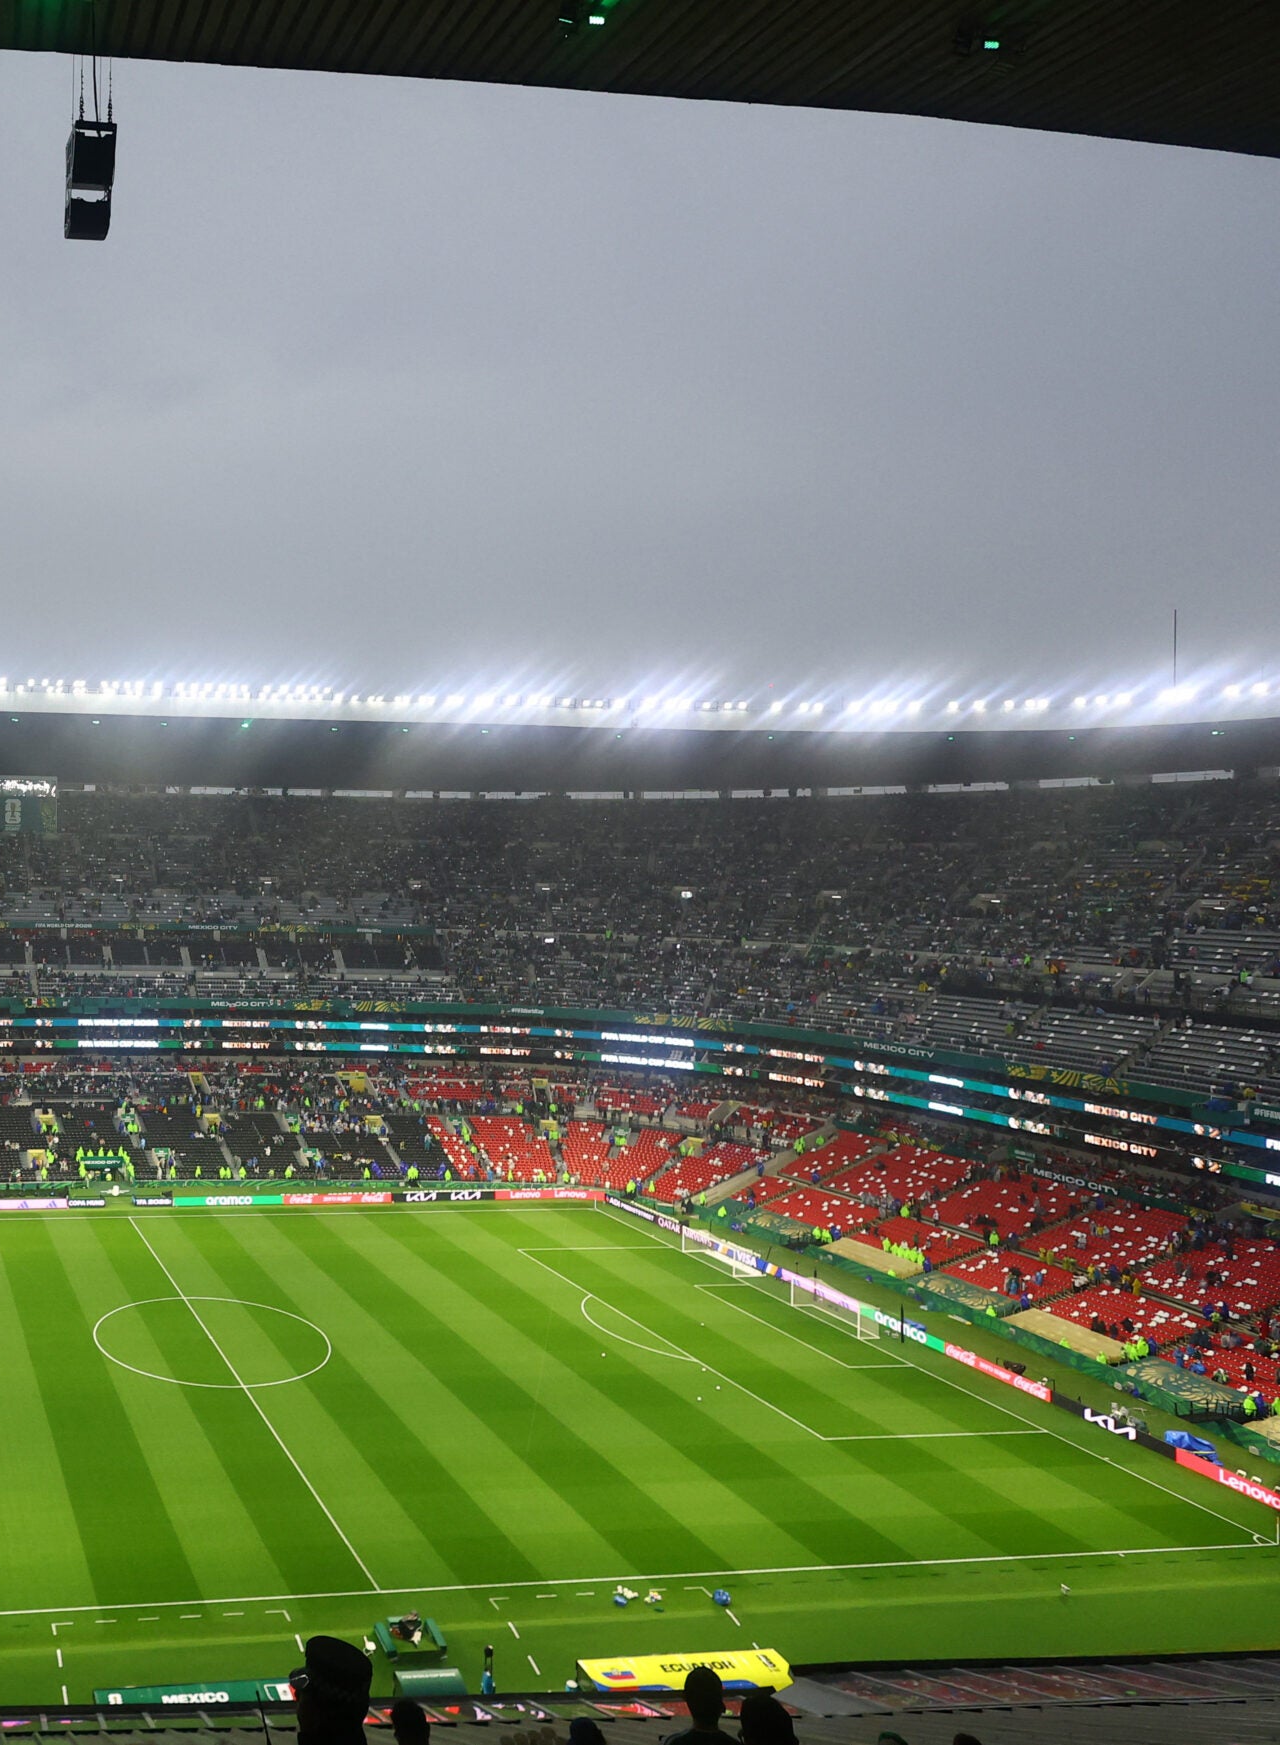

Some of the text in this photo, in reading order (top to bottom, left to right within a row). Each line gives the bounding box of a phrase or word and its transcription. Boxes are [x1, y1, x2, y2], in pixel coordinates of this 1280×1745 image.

[863, 1042, 935, 1058] MEXICO CITY
[1084, 1103, 1157, 1124] MEXICO CITY
[1084, 1134, 1157, 1158] MEXICO CITY
[1033, 1168, 1085, 1186] MEXICO
[205, 1196, 253, 1205] aramco
[510, 1190, 541, 1199] Lenovo
[554, 1190, 587, 1199] Lenovo
[658, 1218, 712, 1247] QATAR AIRWAYS
[737, 1250, 757, 1268] VISA
[874, 1311, 927, 1344] aramco
[1219, 1469, 1280, 1510] Lenovo
[660, 1661, 735, 1673] ECUADOR
[162, 1691, 229, 1704] MEXICO
